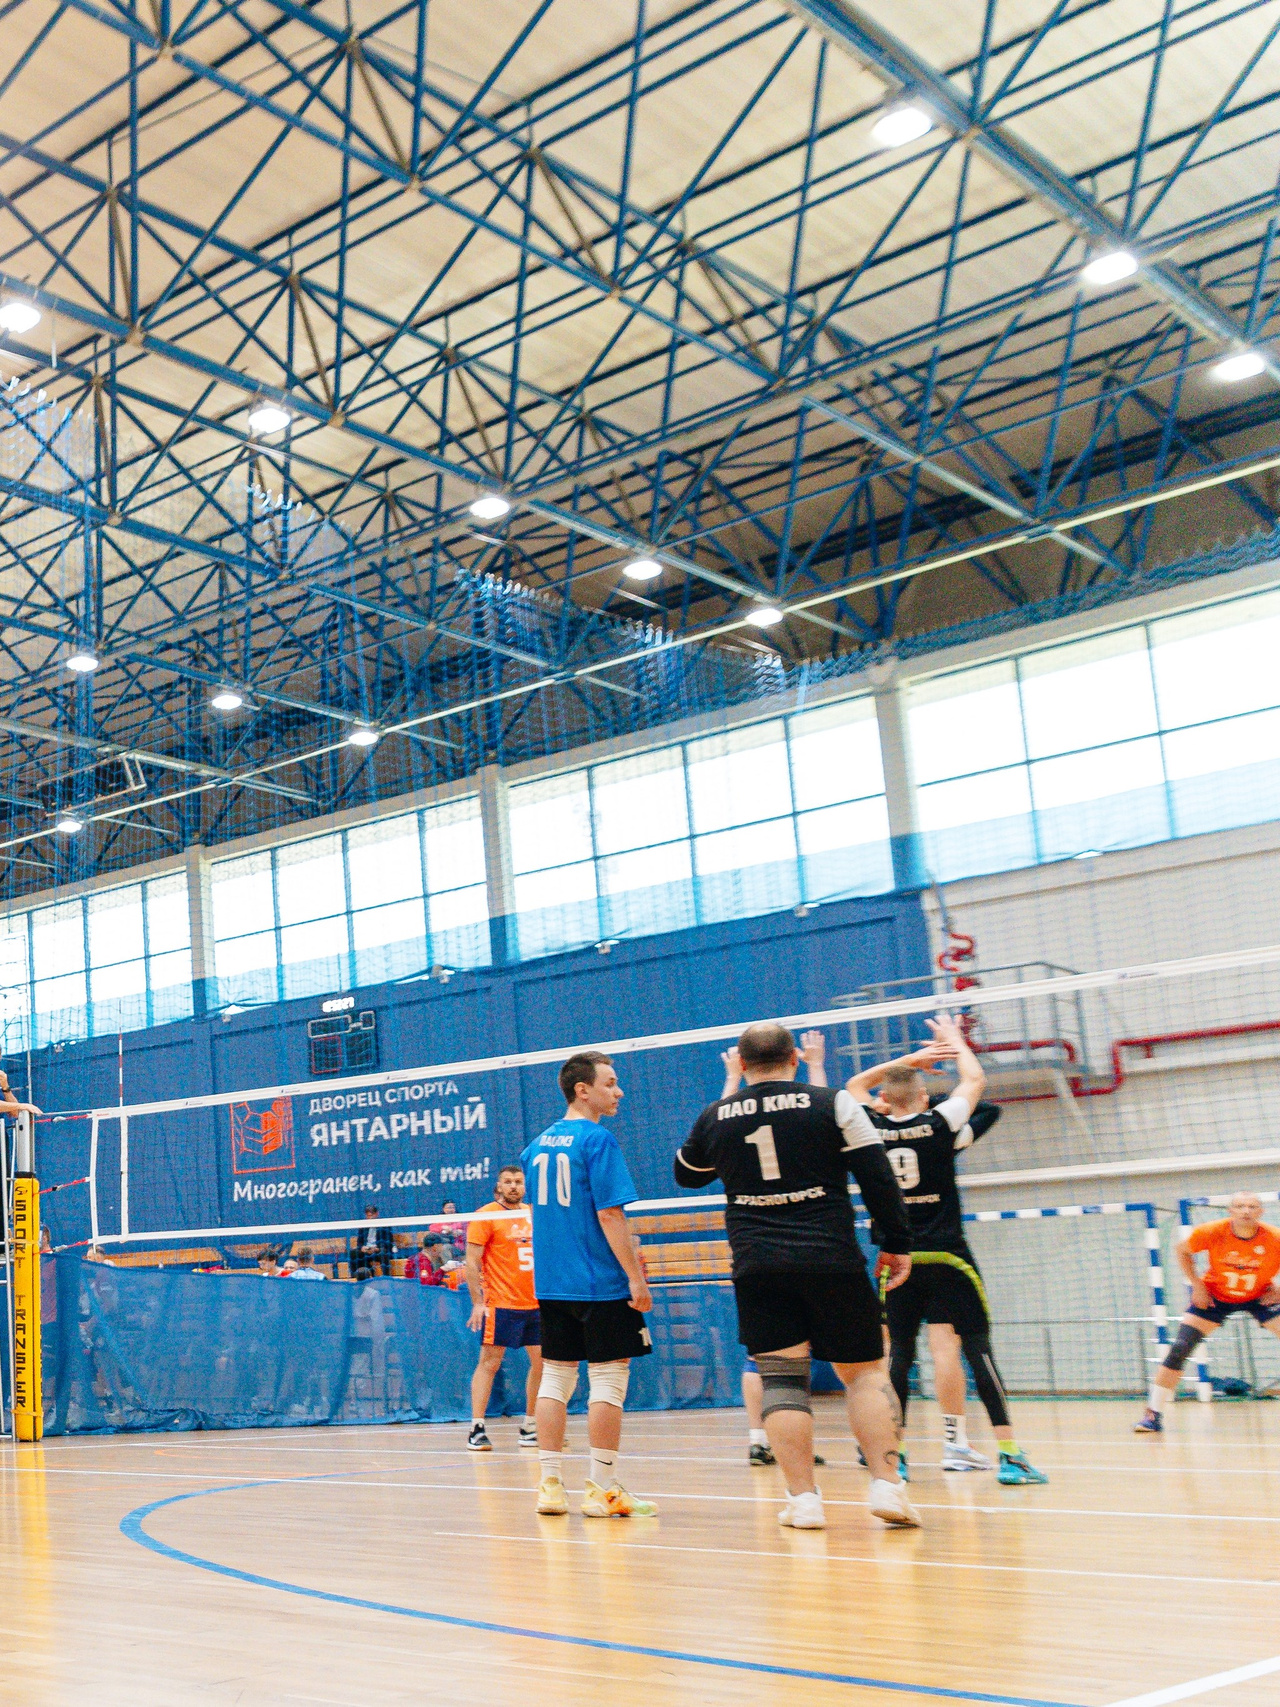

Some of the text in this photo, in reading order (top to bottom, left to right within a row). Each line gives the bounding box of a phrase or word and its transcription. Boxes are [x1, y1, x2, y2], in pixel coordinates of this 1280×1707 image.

[308, 1080, 459, 1116] ДВОРЕЦ СПОРТА
[718, 1093, 812, 1121] ПАО КМЗ
[310, 1096, 487, 1147] ЯНТАРНЫЙ
[744, 1125, 781, 1180] 1
[887, 1147, 920, 1190] 9
[233, 1157, 490, 1203] Многогранен, как ты!
[532, 1152, 572, 1207] 10
[518, 1247, 534, 1271] 5
[1221, 1271, 1257, 1291] 11
[15, 1200, 27, 1407] SPORT TRANSFER
